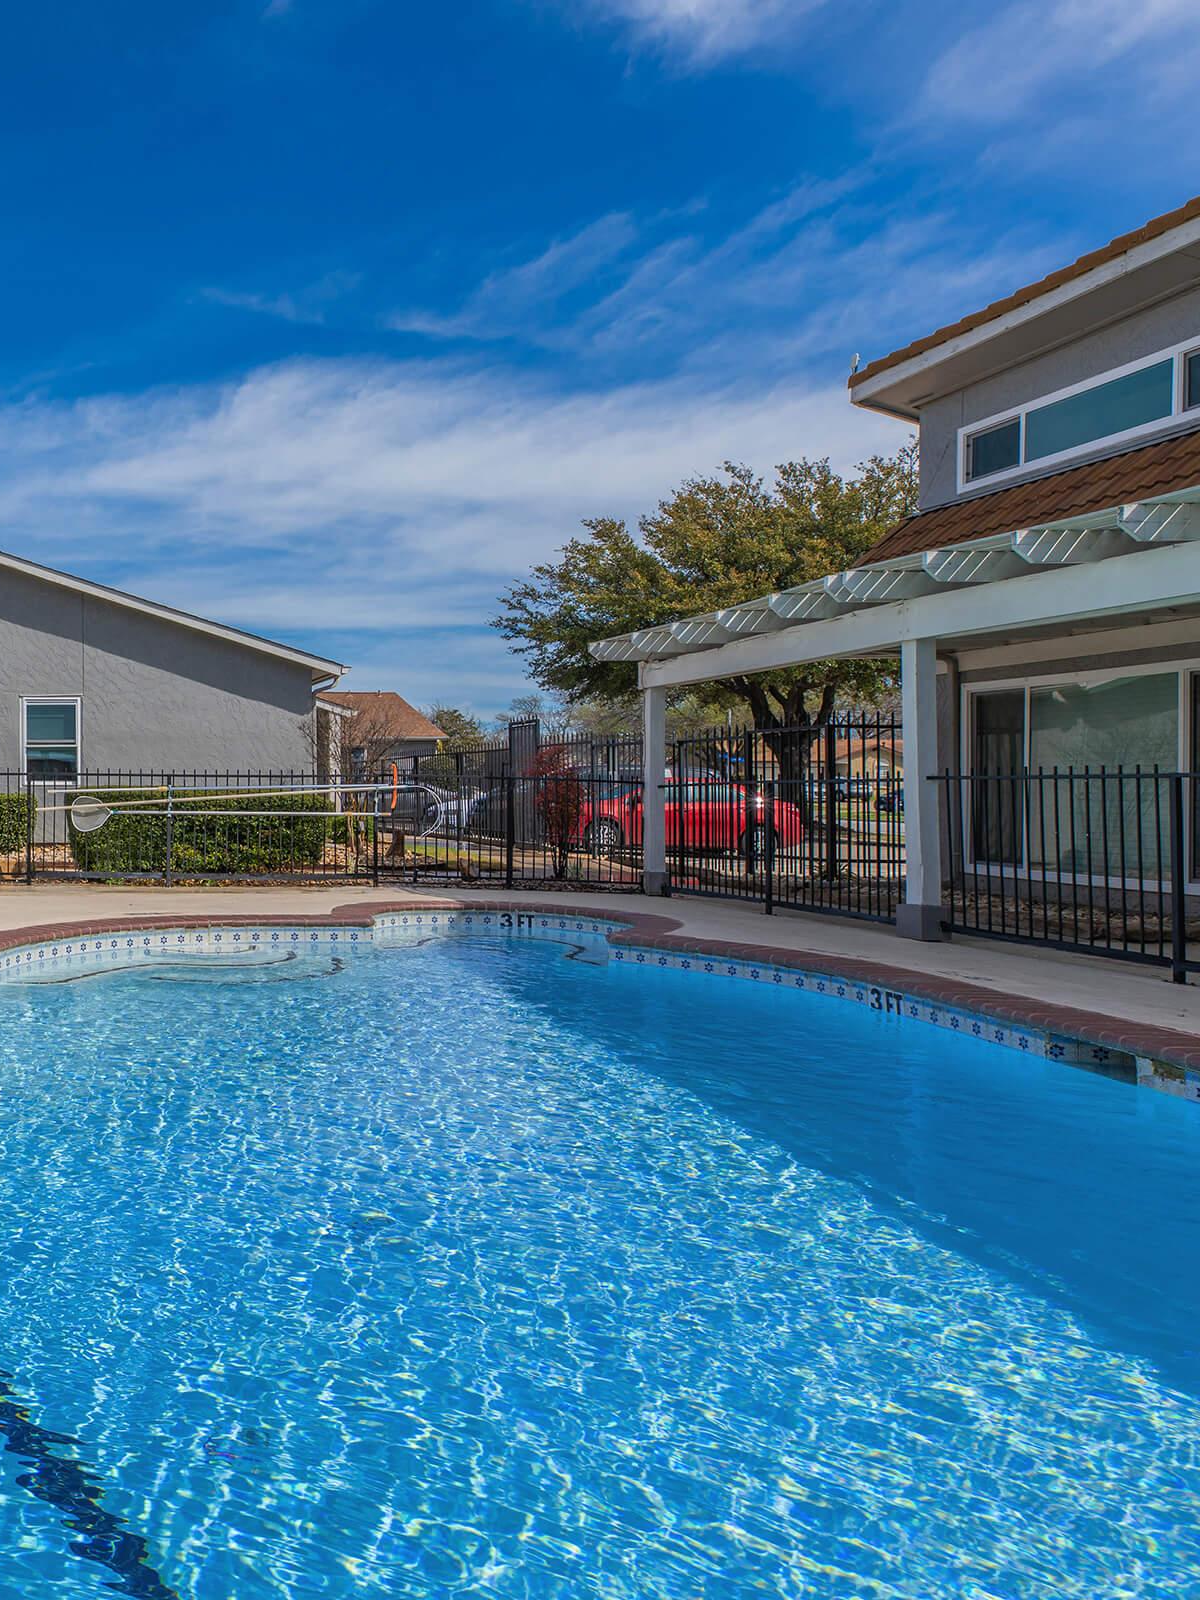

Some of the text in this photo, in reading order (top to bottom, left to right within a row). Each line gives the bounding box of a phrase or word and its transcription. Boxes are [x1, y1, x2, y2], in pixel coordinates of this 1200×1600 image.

[500, 913, 535, 929] 3 FT
[870, 987, 903, 1016] 3 FT
